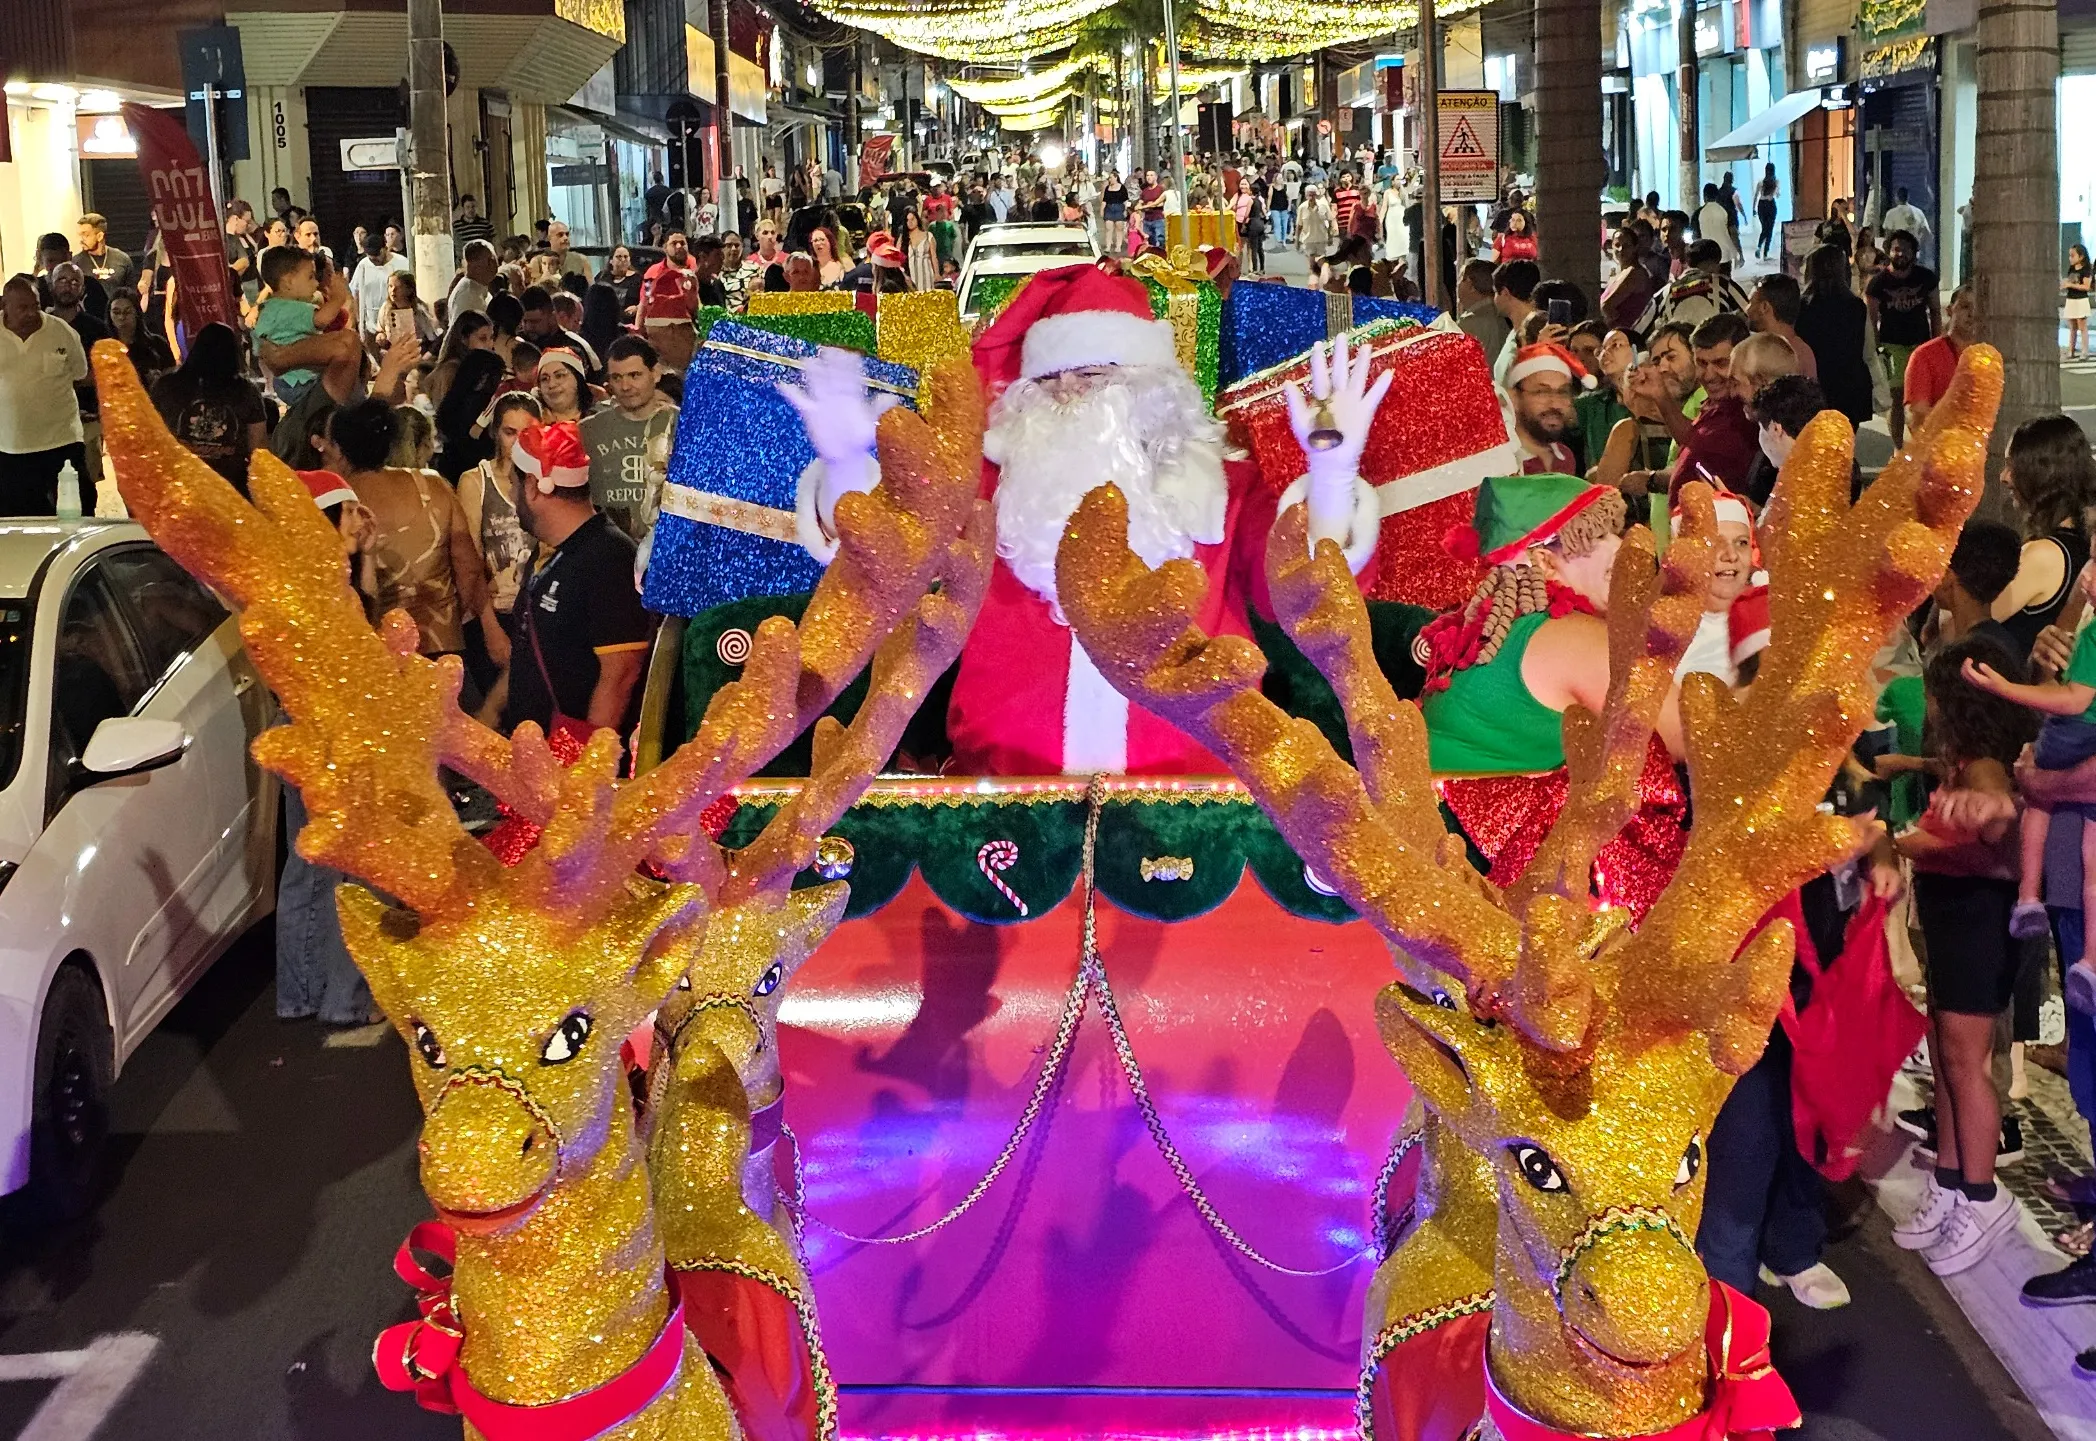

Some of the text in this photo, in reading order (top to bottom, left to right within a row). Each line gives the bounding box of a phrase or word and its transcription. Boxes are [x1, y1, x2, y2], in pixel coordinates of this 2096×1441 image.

[1441, 97, 1487, 108] ATENÇÃO
[274, 101, 287, 148] 1005
[597, 436, 648, 457] BANA
[606, 488, 647, 502] REPU
